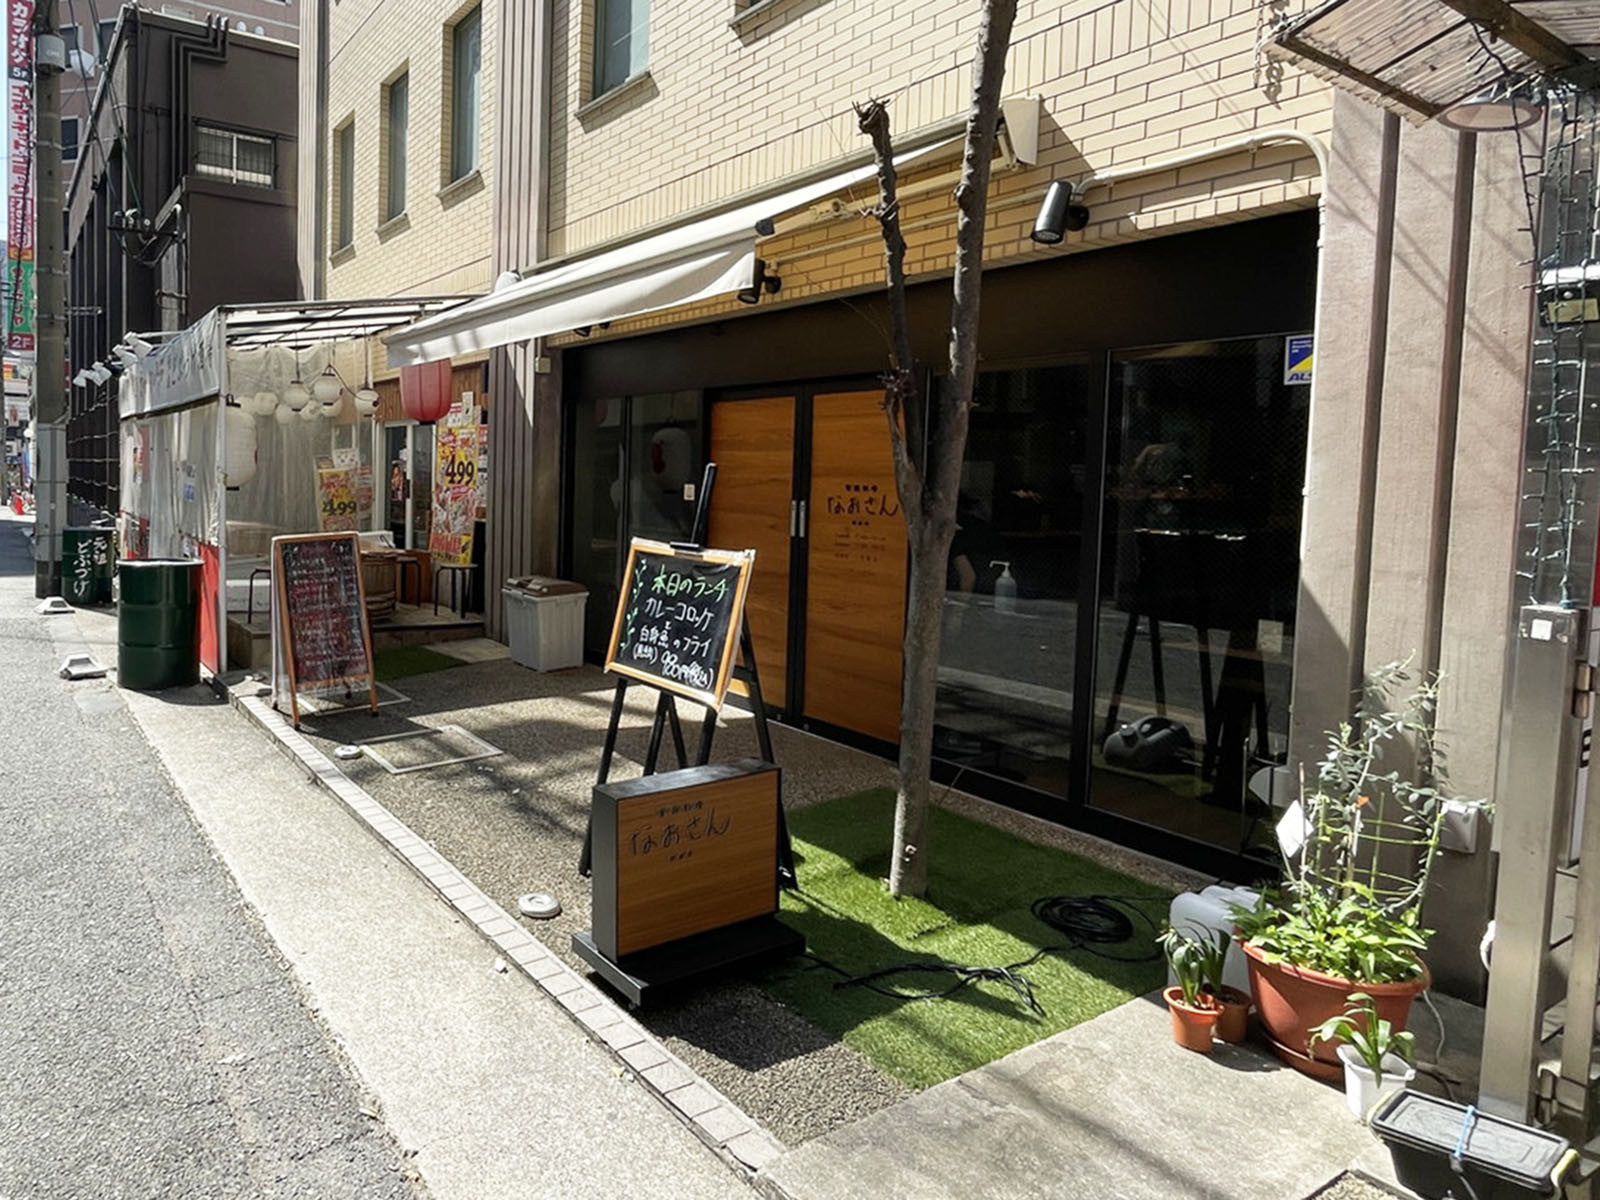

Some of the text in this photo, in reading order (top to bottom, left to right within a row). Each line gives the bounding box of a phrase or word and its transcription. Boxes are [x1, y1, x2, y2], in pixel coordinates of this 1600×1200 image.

[11, 335, 31, 349] 2F
[445, 455, 474, 485] 499
[322, 498, 357, 516] 499
[73, 539, 92, 597] どぶづけ
[651, 564, 728, 602] 本日のランチ
[644, 597, 714, 631] カレーコロッケ
